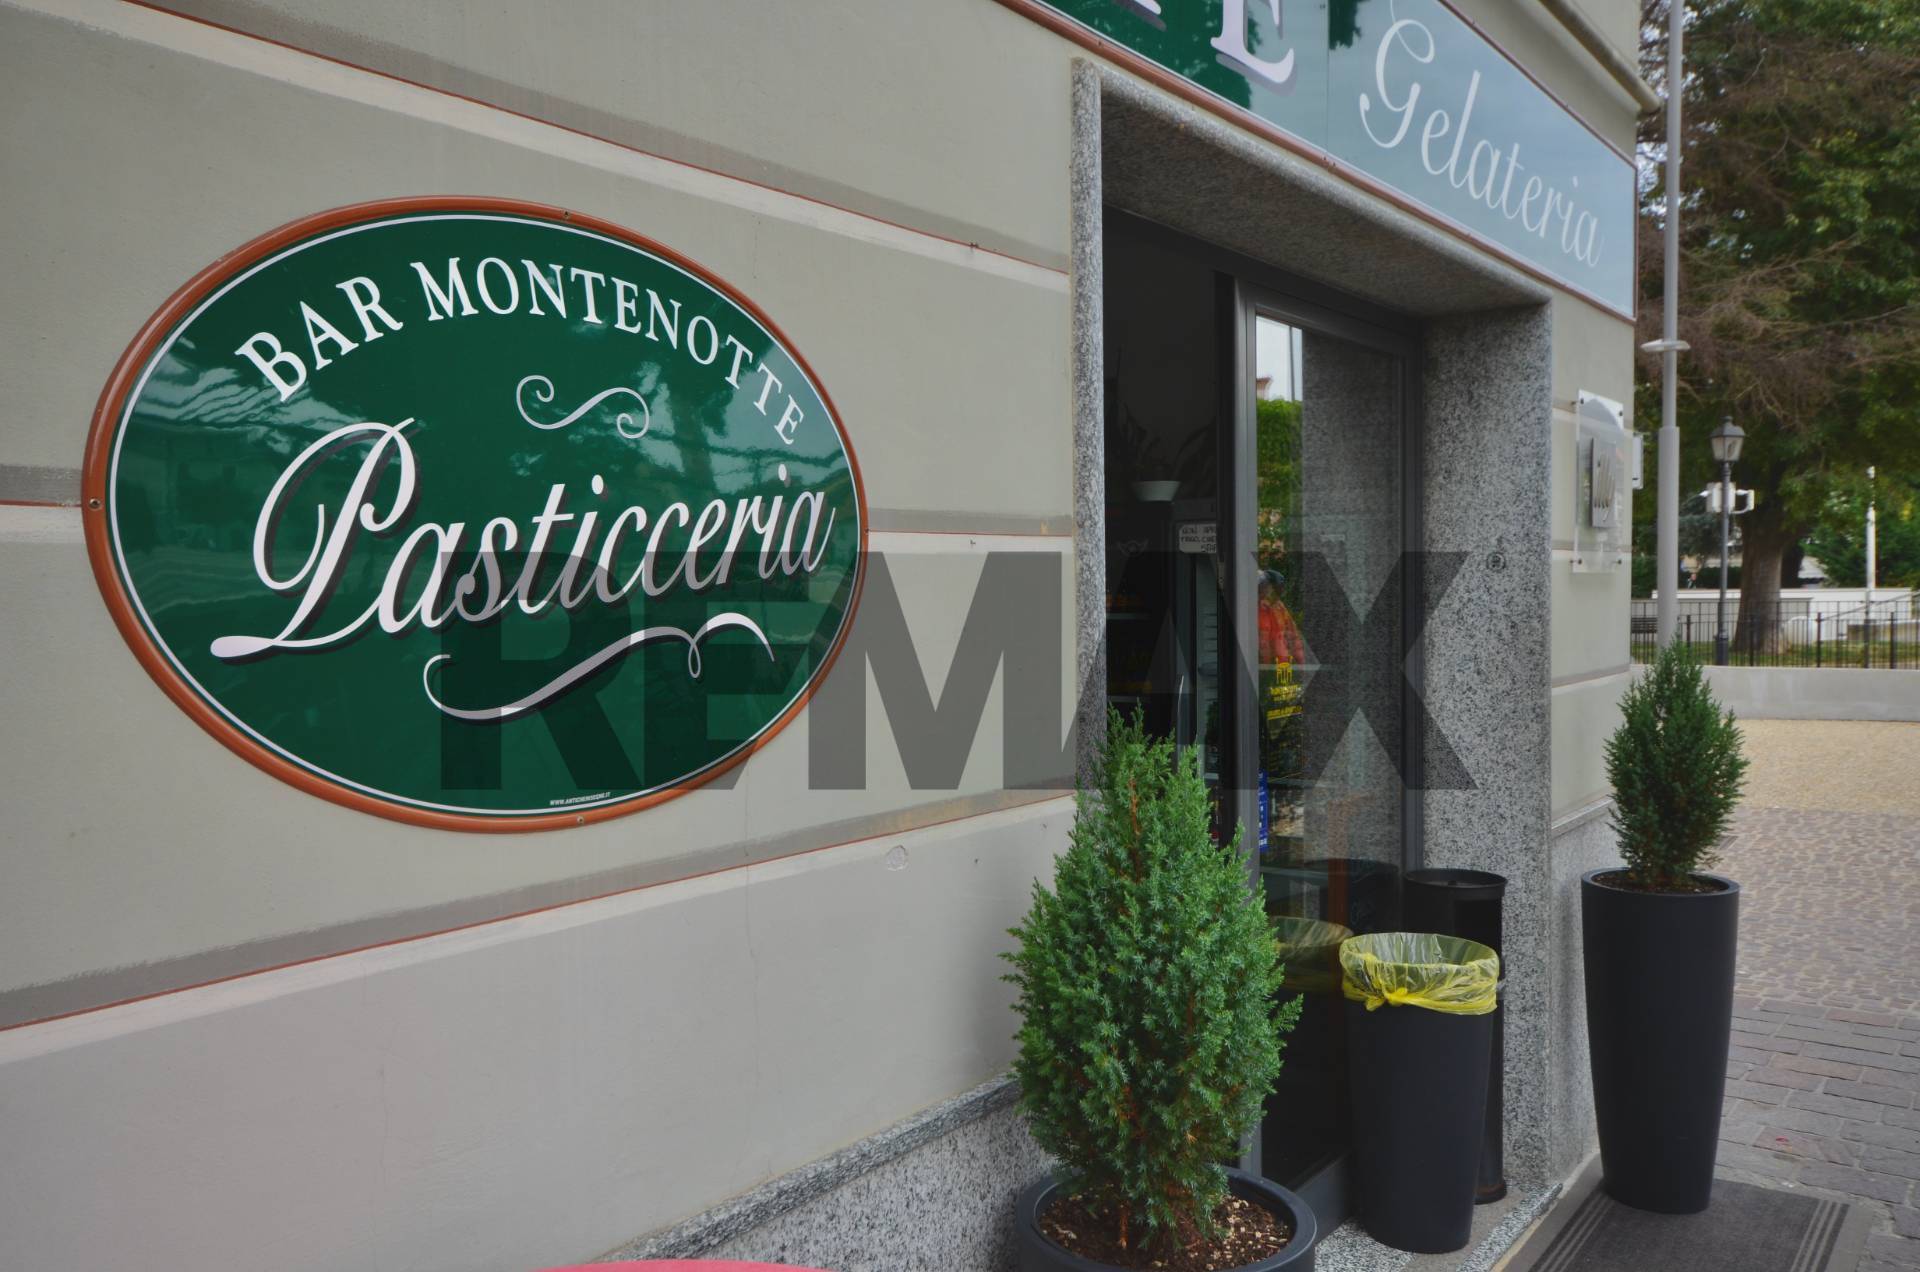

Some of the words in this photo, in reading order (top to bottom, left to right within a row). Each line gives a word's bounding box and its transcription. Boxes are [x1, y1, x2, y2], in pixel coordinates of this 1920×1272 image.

[1359, 0, 1600, 268] Gelateria
[234, 276, 404, 402] BAR
[410, 257, 804, 445] MONTENOTTE
[210, 417, 836, 659] Pasticceria
